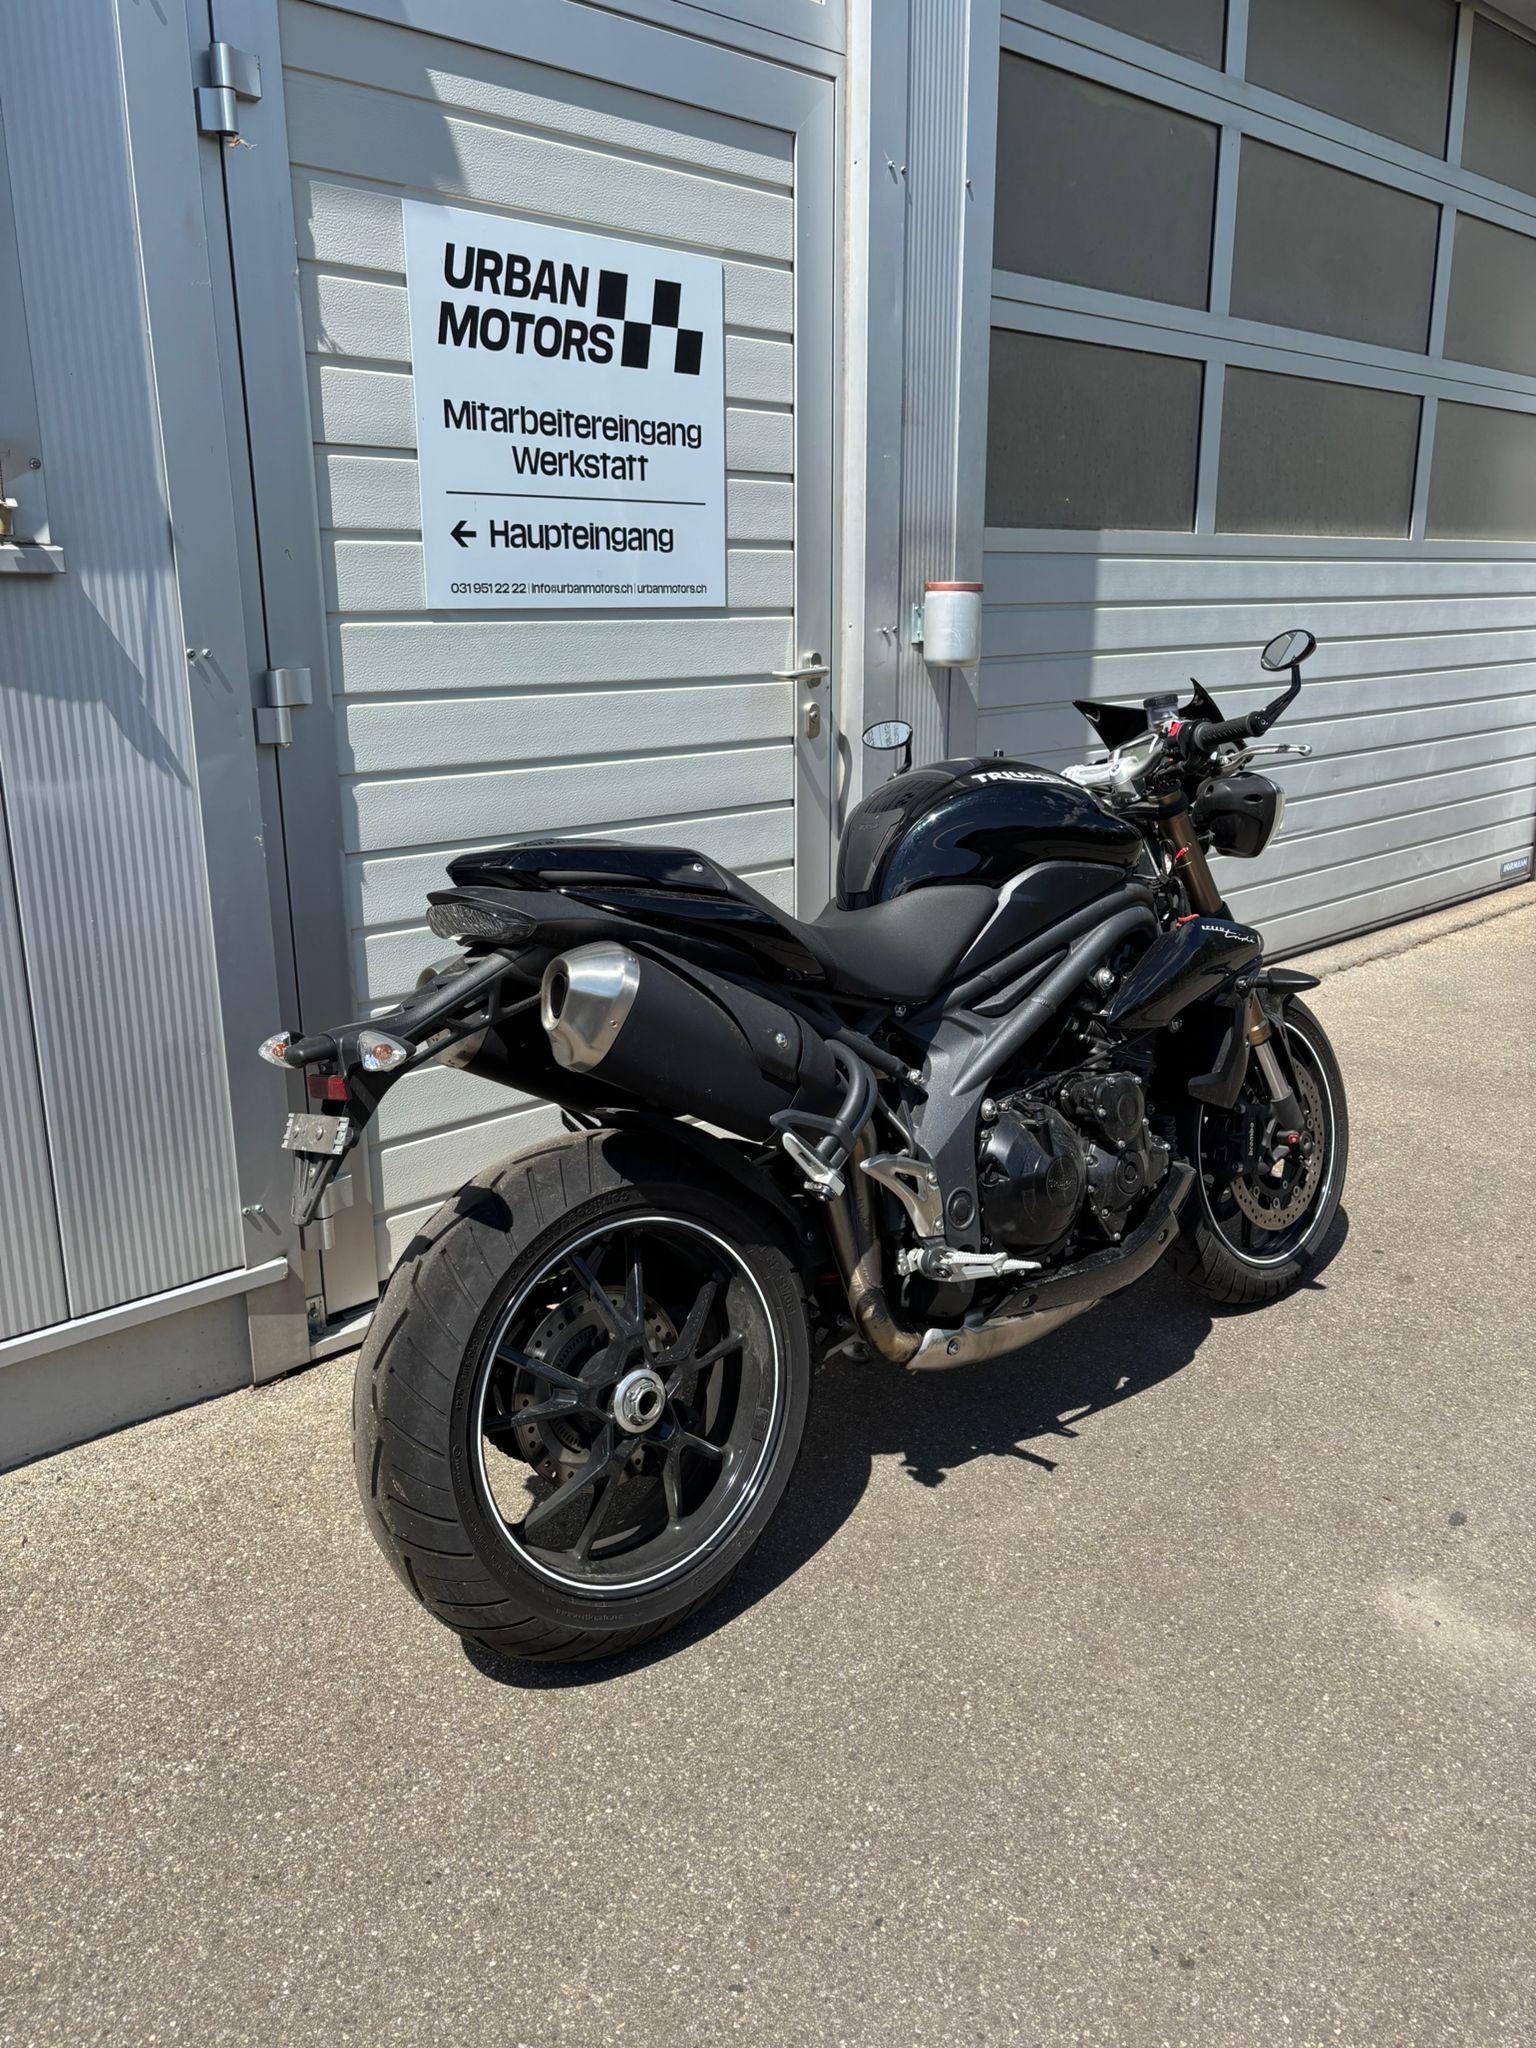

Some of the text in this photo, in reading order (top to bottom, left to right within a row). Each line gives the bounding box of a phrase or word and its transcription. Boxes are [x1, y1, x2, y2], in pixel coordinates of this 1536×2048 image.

[445, 243, 590, 307] URBAN
[437, 301, 615, 364] MOTORS
[444, 399, 702, 449] Mitarbeitereingang
[512, 446, 649, 481] Werkstatt
[489, 520, 674, 553] Haupteingang
[450, 582, 471, 594] 031
[473, 582, 493, 594] 951
[494, 582, 510, 594] 22
[511, 582, 527, 594] 22
[637, 584, 708, 594] urbanmotors.ch
